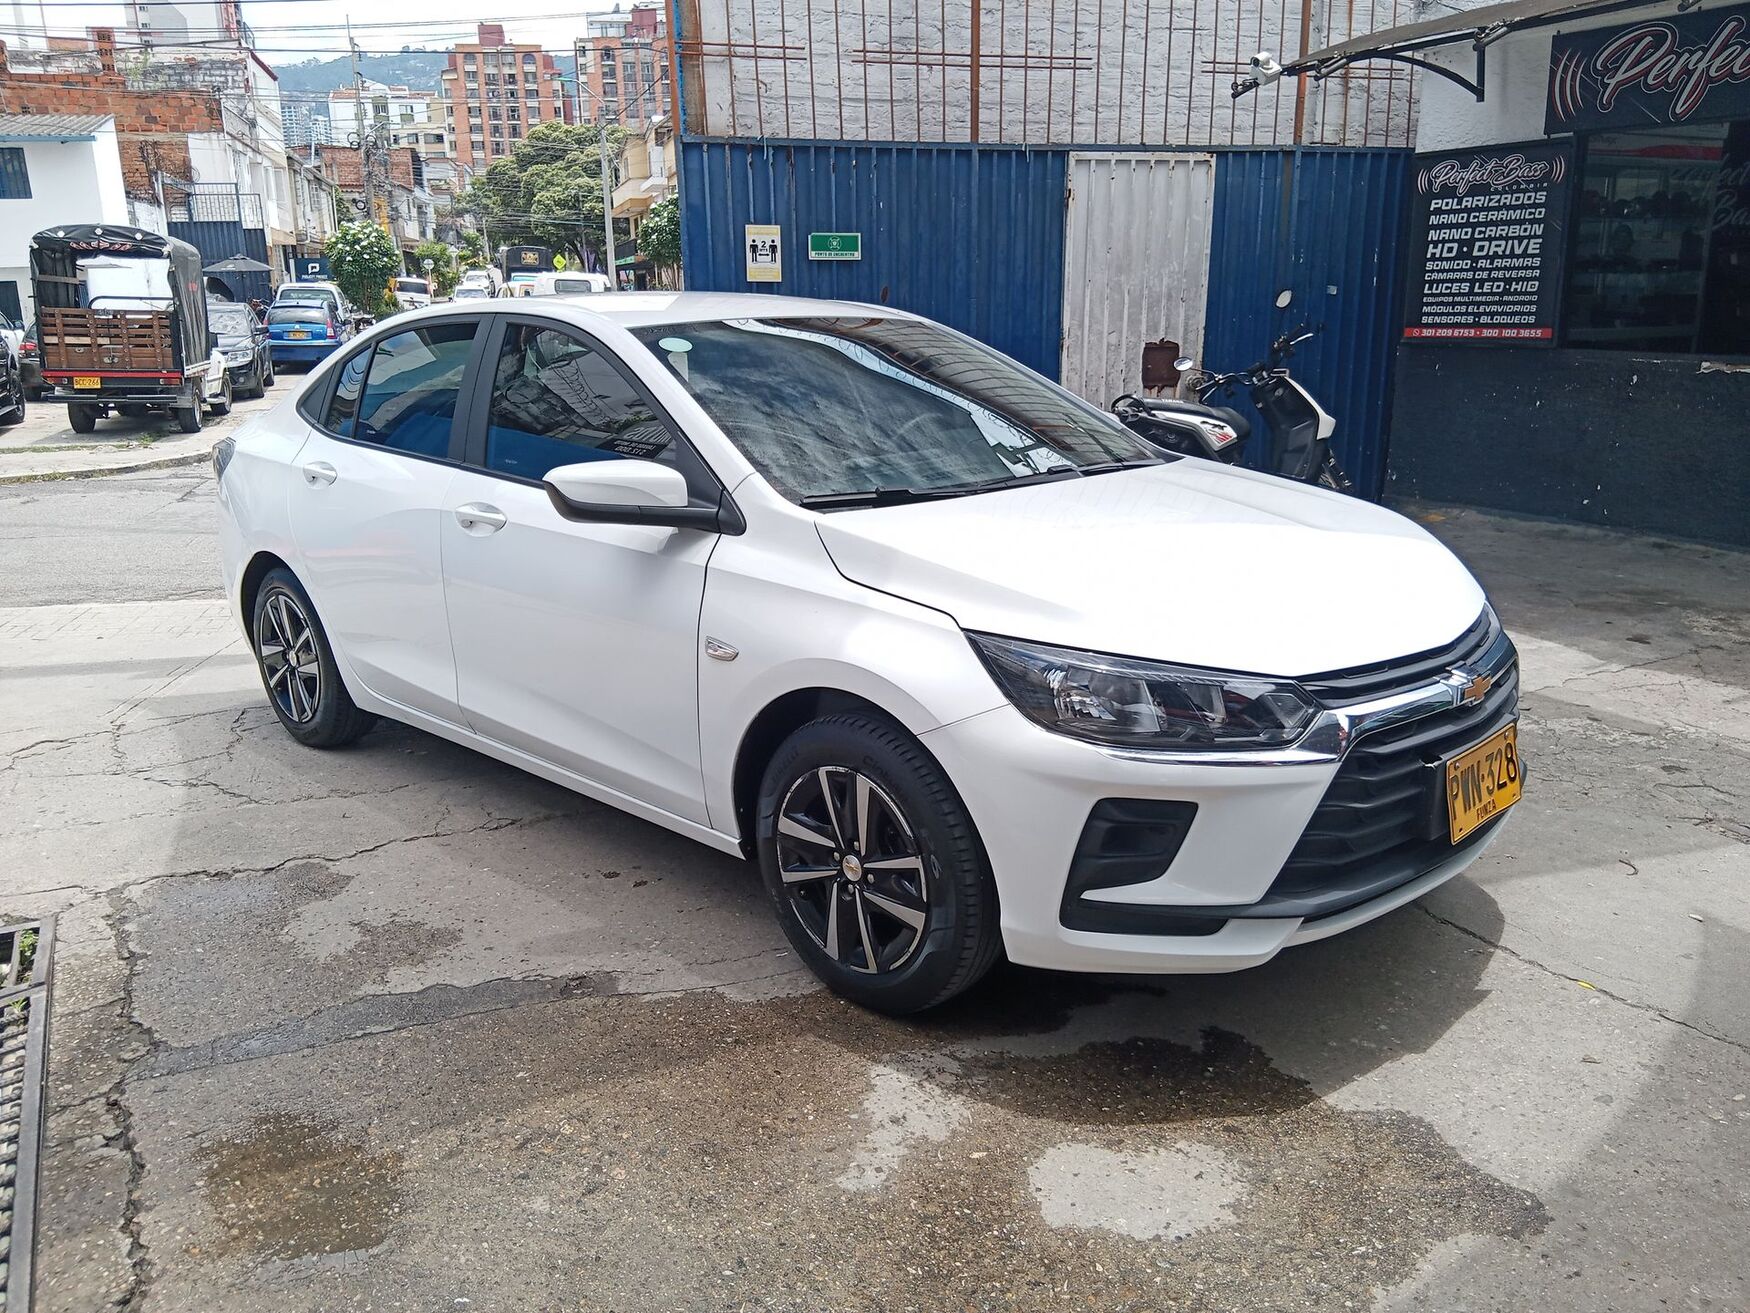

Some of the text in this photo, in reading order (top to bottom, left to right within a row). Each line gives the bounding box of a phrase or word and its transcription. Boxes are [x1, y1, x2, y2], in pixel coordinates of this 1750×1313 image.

[1430, 154, 1549, 196] Perfect Bass
[1430, 192, 1547, 211] POLARIZADOS
[1429, 213, 1467, 225] NANO
[1428, 222, 1544, 241] NANO CARBÓN
[761, 240, 767, 248] 2
[1426, 238, 1543, 258] HD DRIVE
[1425, 257, 1541, 270] SONIDO ALARMAS
[1475, 271, 1489, 279] DE
[1490, 269, 1540, 278] REVERSA
[1423, 281, 1540, 294] LUCES LED HID
[1468, 305, 1537, 313] ELEVAVIDRIOS
[1421, 315, 1536, 324] SENSORES BLOQUEOS
[1421, 329, 1434, 337] 301
[1481, 329, 1499, 337] 300
[1501, 329, 1517, 337] 100
[1518, 329, 1542, 337] 3655
[1477, 798, 1497, 821] FUNZA
